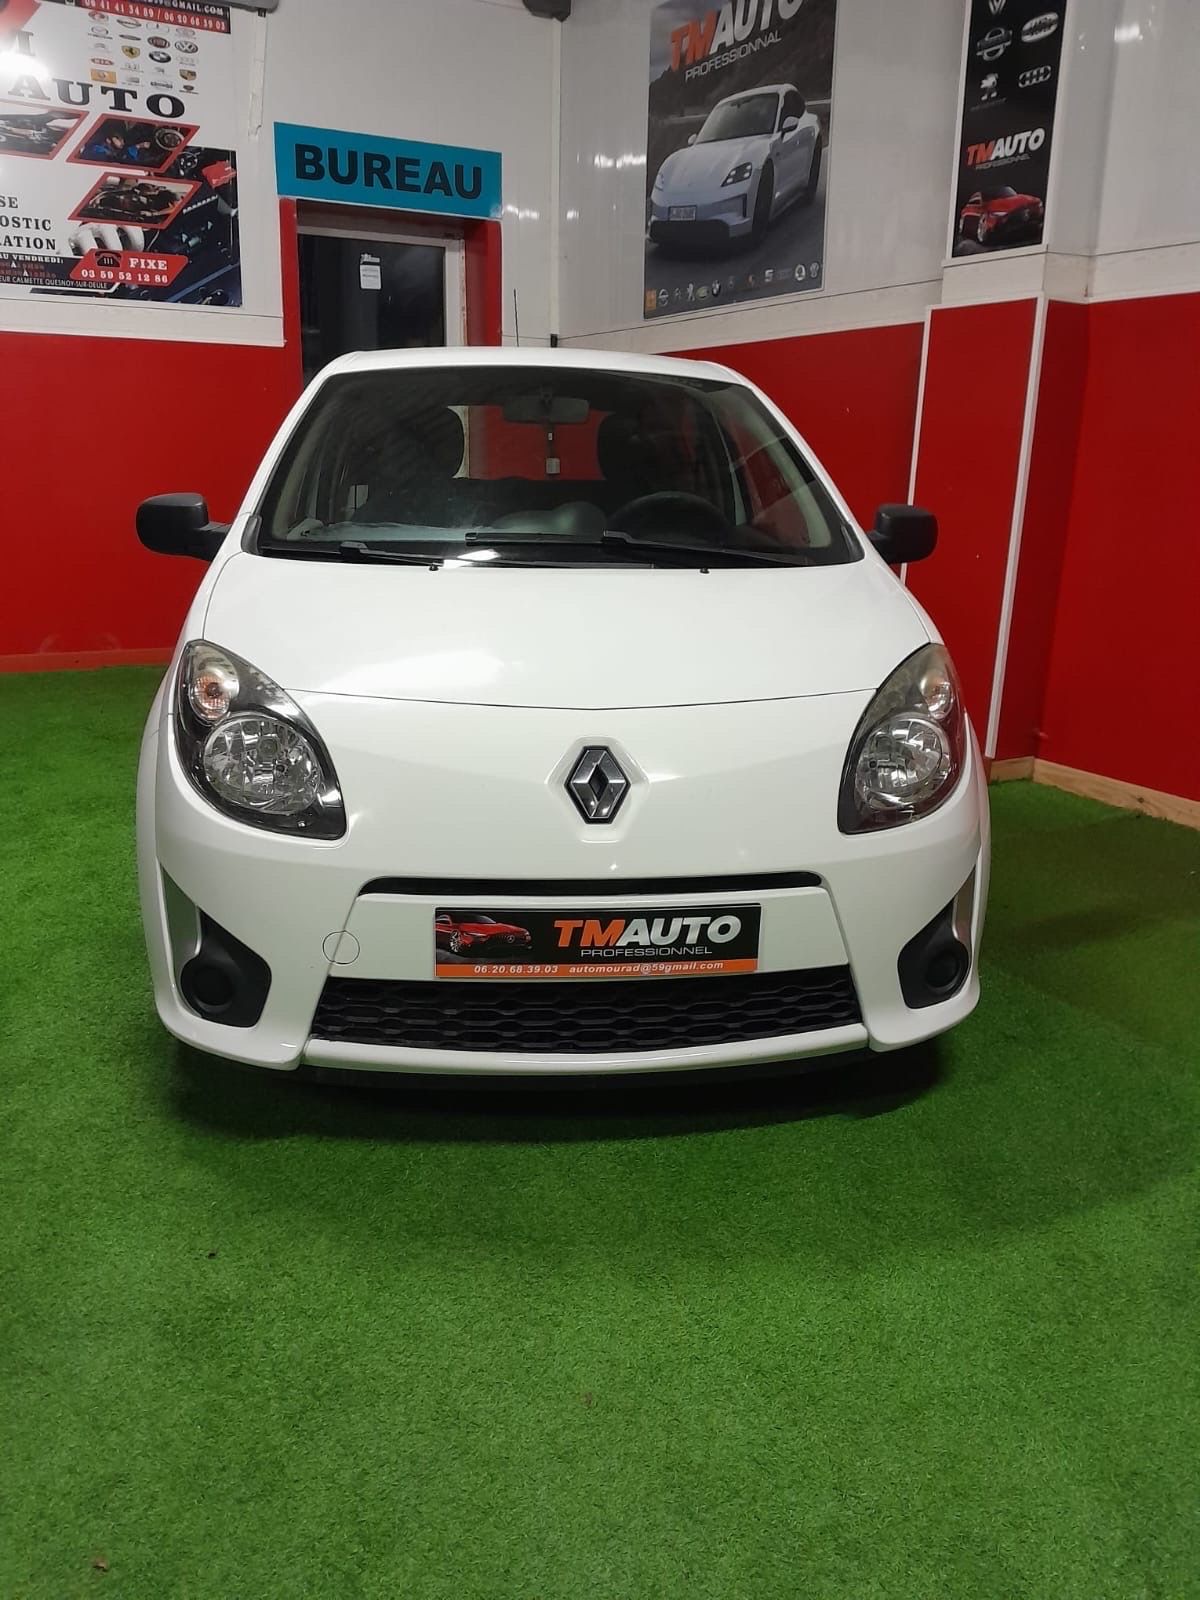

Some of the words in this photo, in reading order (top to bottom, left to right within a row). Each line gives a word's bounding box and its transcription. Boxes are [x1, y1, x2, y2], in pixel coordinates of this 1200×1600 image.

[684, 30, 782, 82] PROFESSIONNAL
[8, 73, 185, 118] AUTO
[967, 127, 1046, 166] TMAUTO
[294, 143, 482, 200] BUREAU
[0, 234, 56, 250] ATION
[129, 257, 168, 271] FIXE
[12, 276, 44, 286] CALMETTE
[81, 269, 96, 279] 03
[118, 271, 133, 281] 52
[137, 273, 150, 283] 12
[554, 914, 742, 948] TMAUTO
[580, 945, 713, 959] PROFESSIONNEL
[473, 964, 559, 975] 06.20.68.39.03
[568, 959, 725, 976] automourad@59gmail.com
